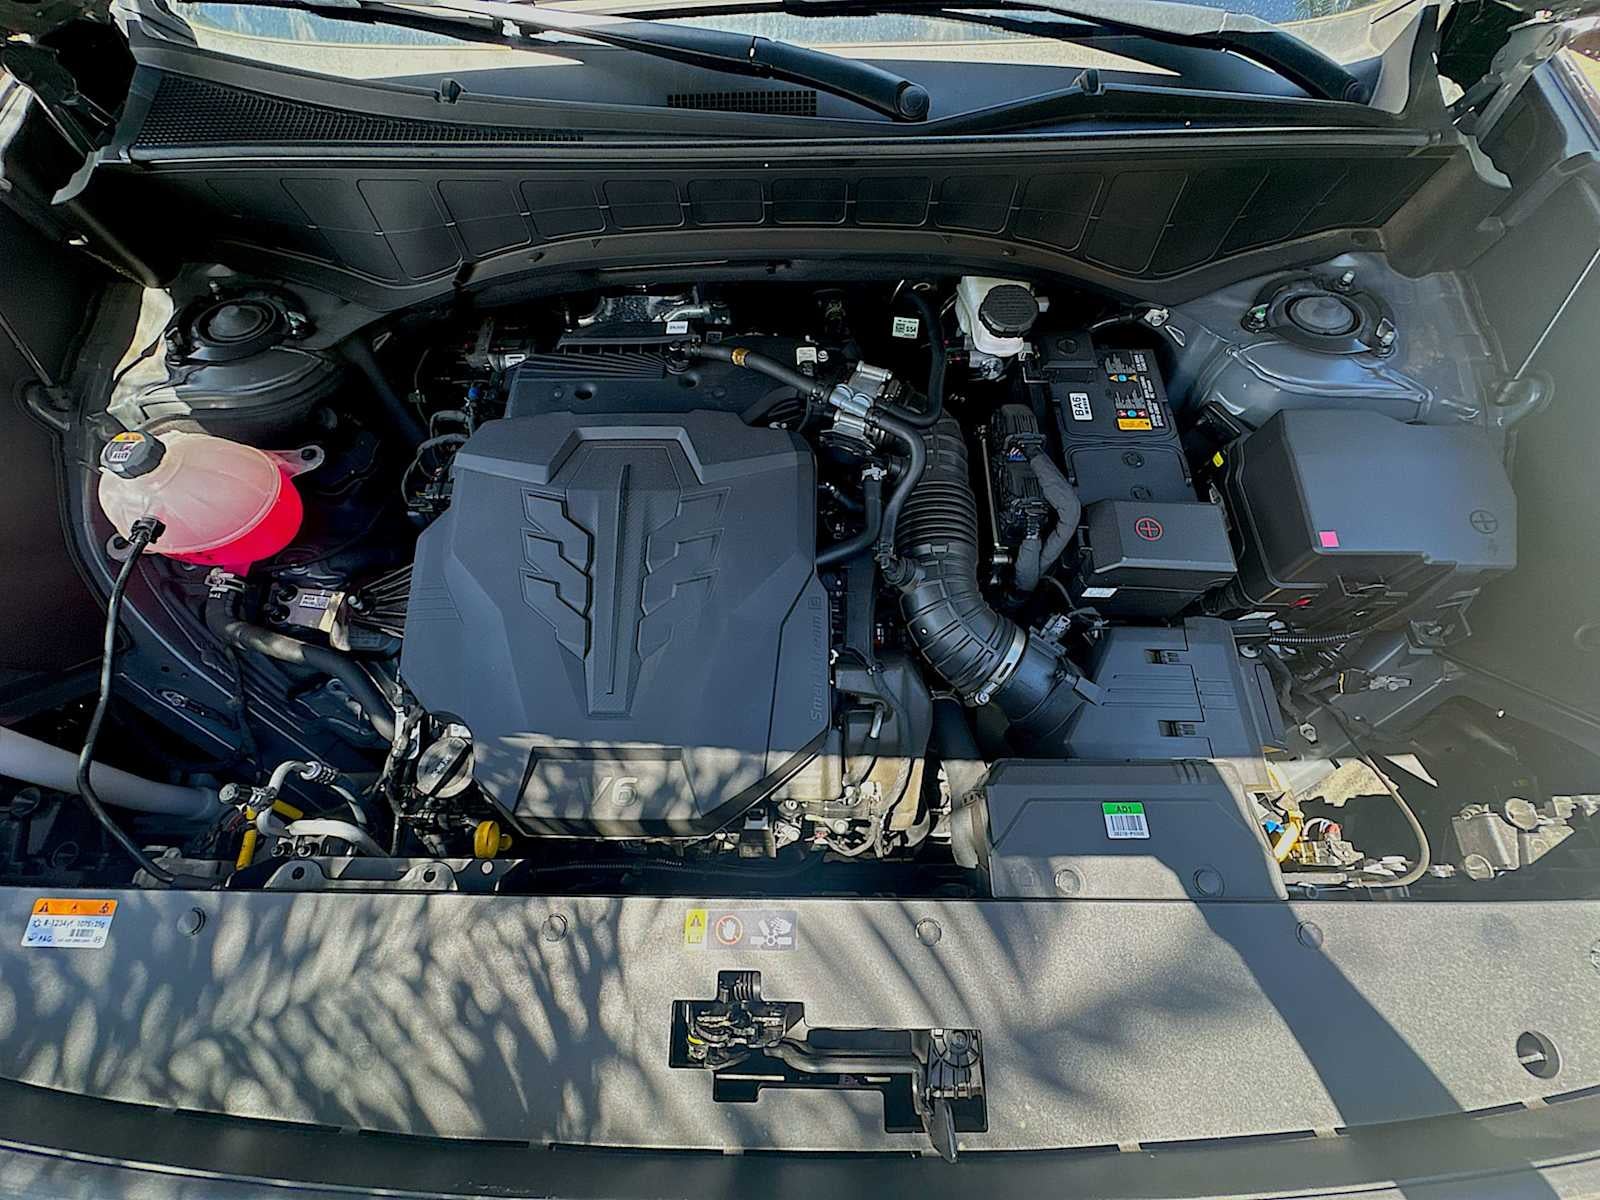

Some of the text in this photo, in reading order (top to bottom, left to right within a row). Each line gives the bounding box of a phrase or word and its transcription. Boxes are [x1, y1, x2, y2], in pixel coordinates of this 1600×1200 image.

[1072, 396, 1084, 416] BA6
[810, 616, 823, 721] Smartstream
[580, 776, 638, 807] V6
